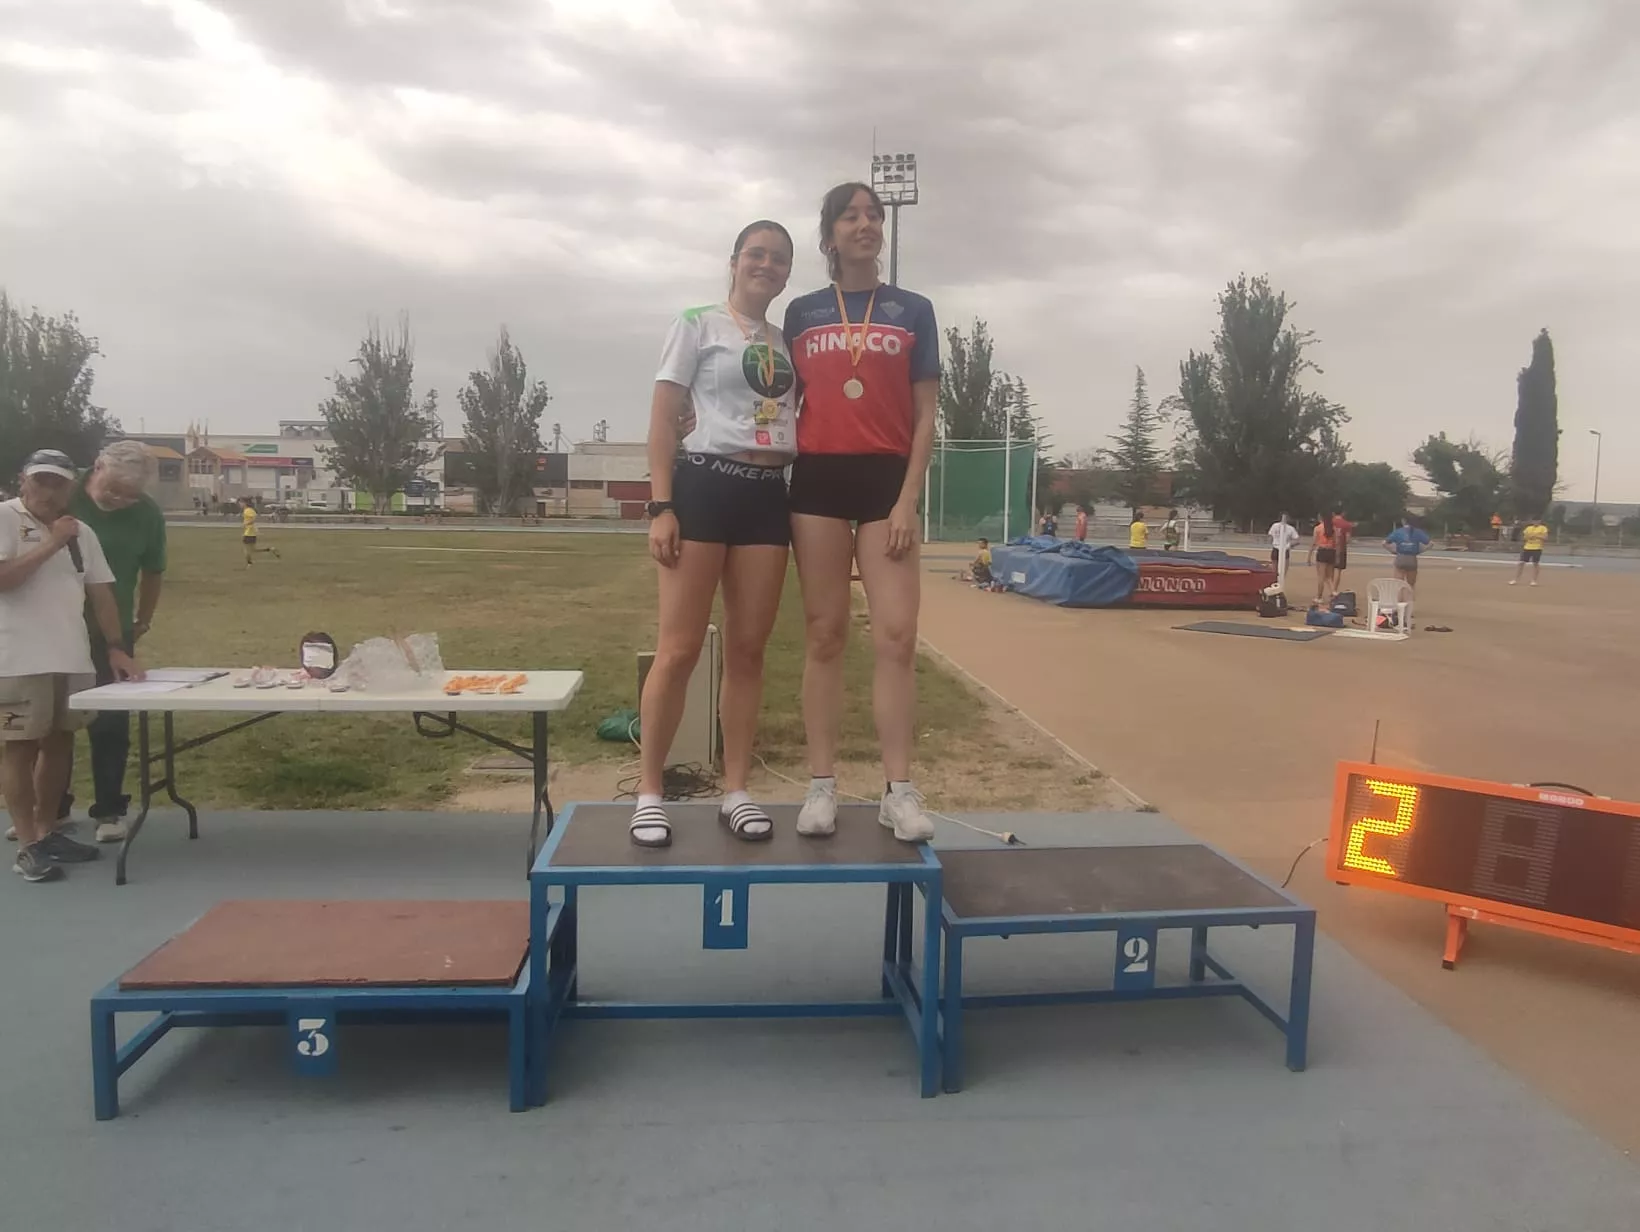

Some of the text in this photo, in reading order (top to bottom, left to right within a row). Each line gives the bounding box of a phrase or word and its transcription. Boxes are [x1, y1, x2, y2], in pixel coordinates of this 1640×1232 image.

[711, 460, 760, 479] NIKE
[1136, 576, 1206, 593] MONDO
[1344, 779, 1418, 875] 2
[715, 889, 735, 926] 1
[1123, 937, 1149, 973] 2
[297, 1018, 329, 1056] 3
